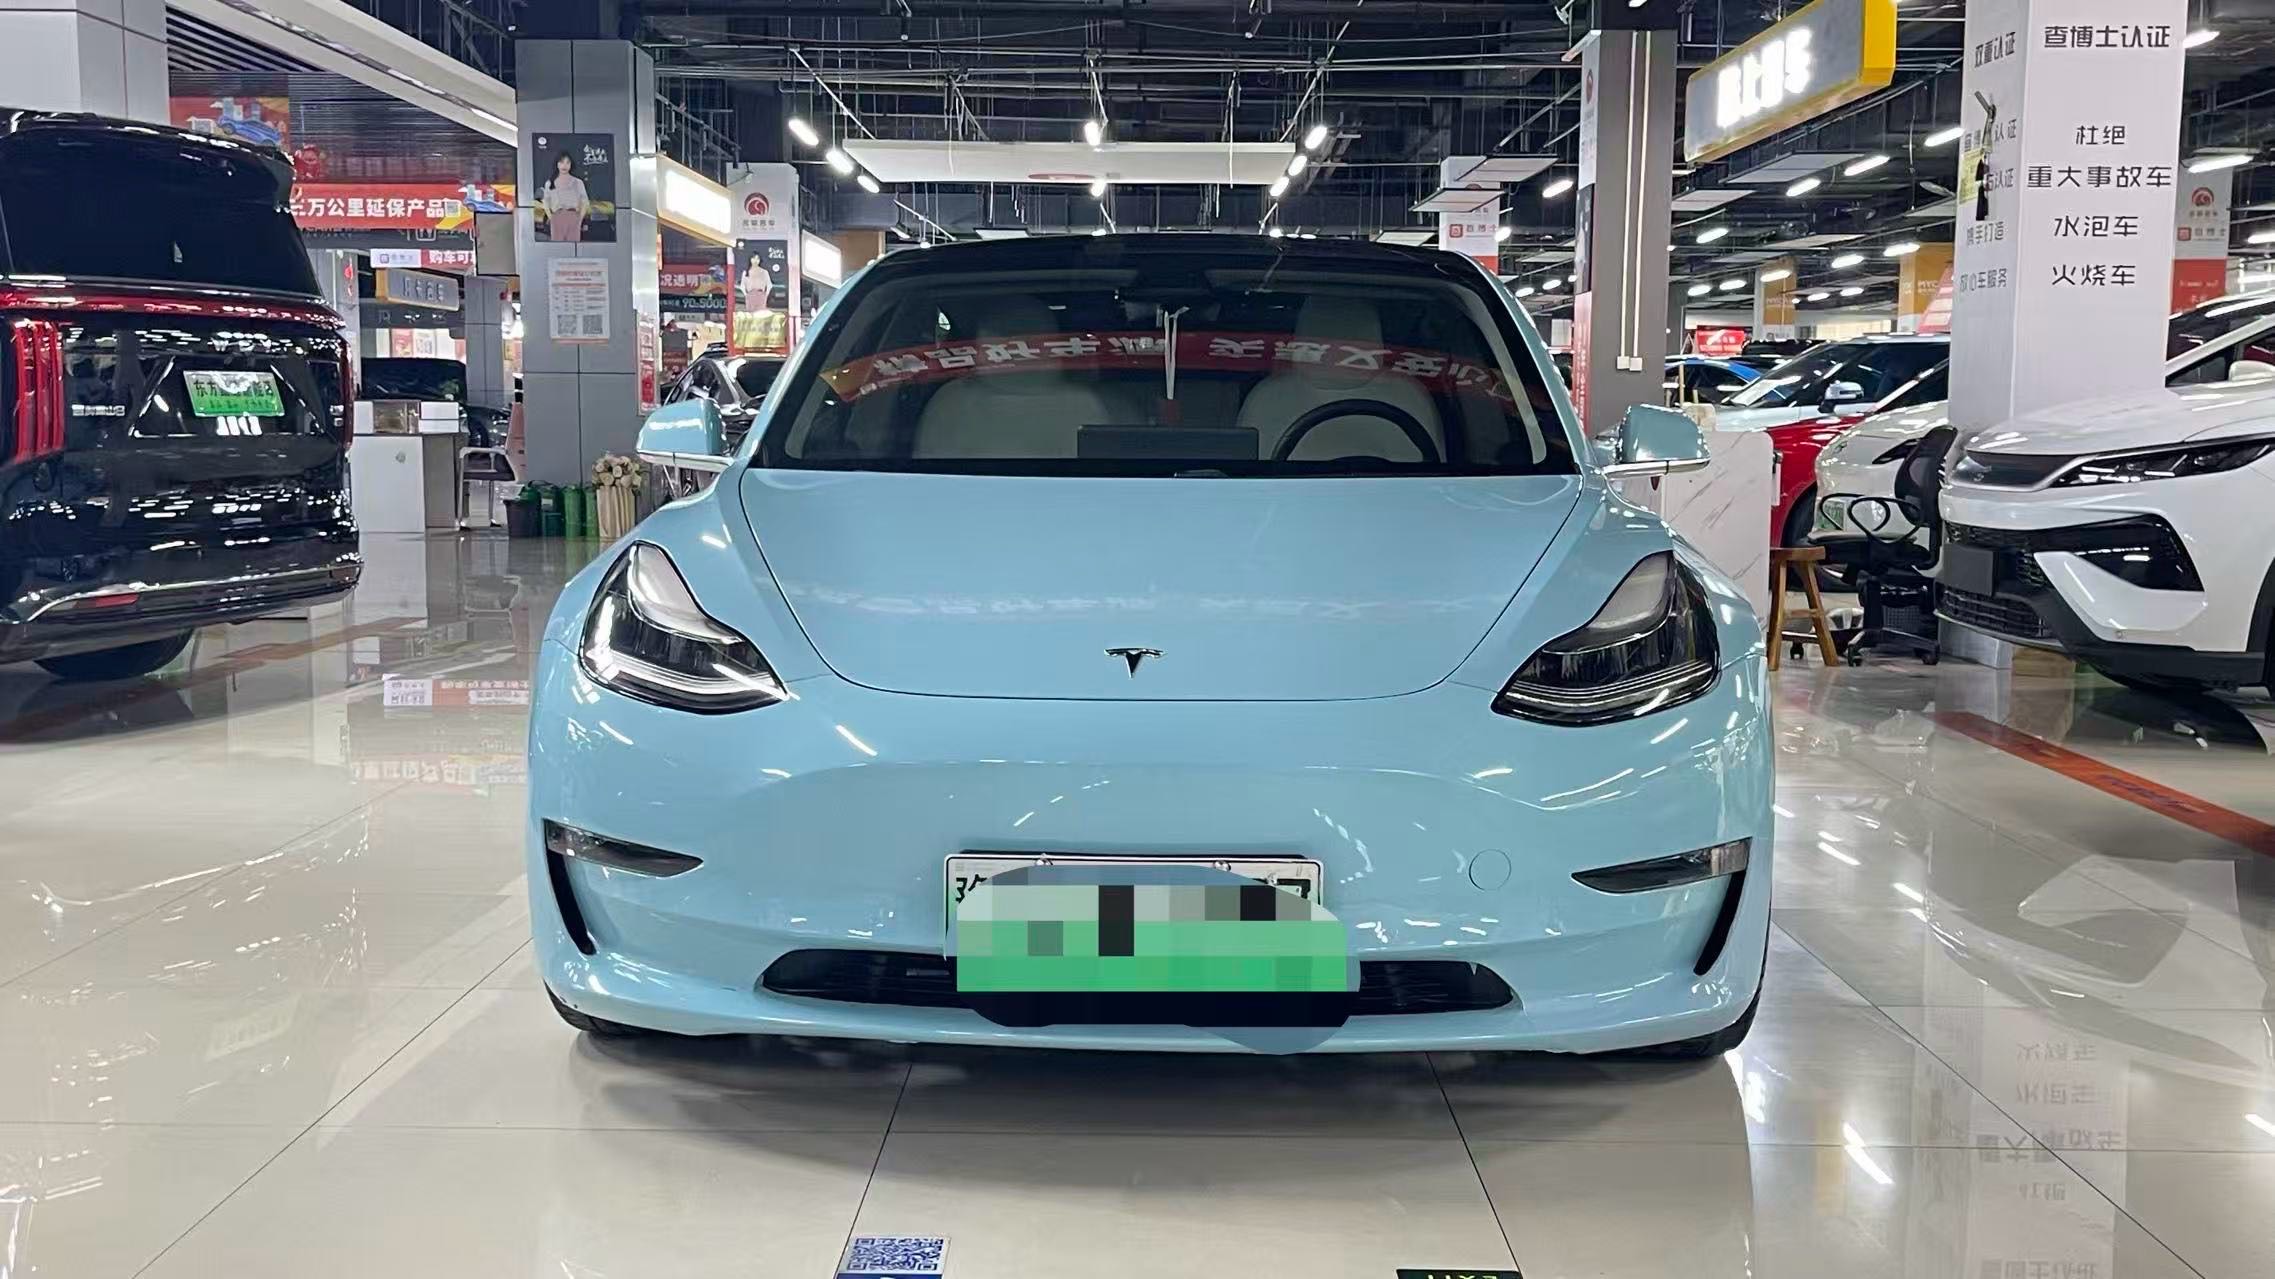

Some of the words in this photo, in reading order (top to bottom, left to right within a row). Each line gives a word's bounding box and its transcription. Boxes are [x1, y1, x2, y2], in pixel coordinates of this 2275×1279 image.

[2044, 25, 2171, 48] 查博士认证
[2075, 125, 2126, 145] 杜绝
[2027, 165, 2172, 188] 重大事故车
[2053, 215, 2139, 237] 水泡车
[428, 250, 474, 264] 购车可
[2052, 264, 2137, 287] 火烧车
